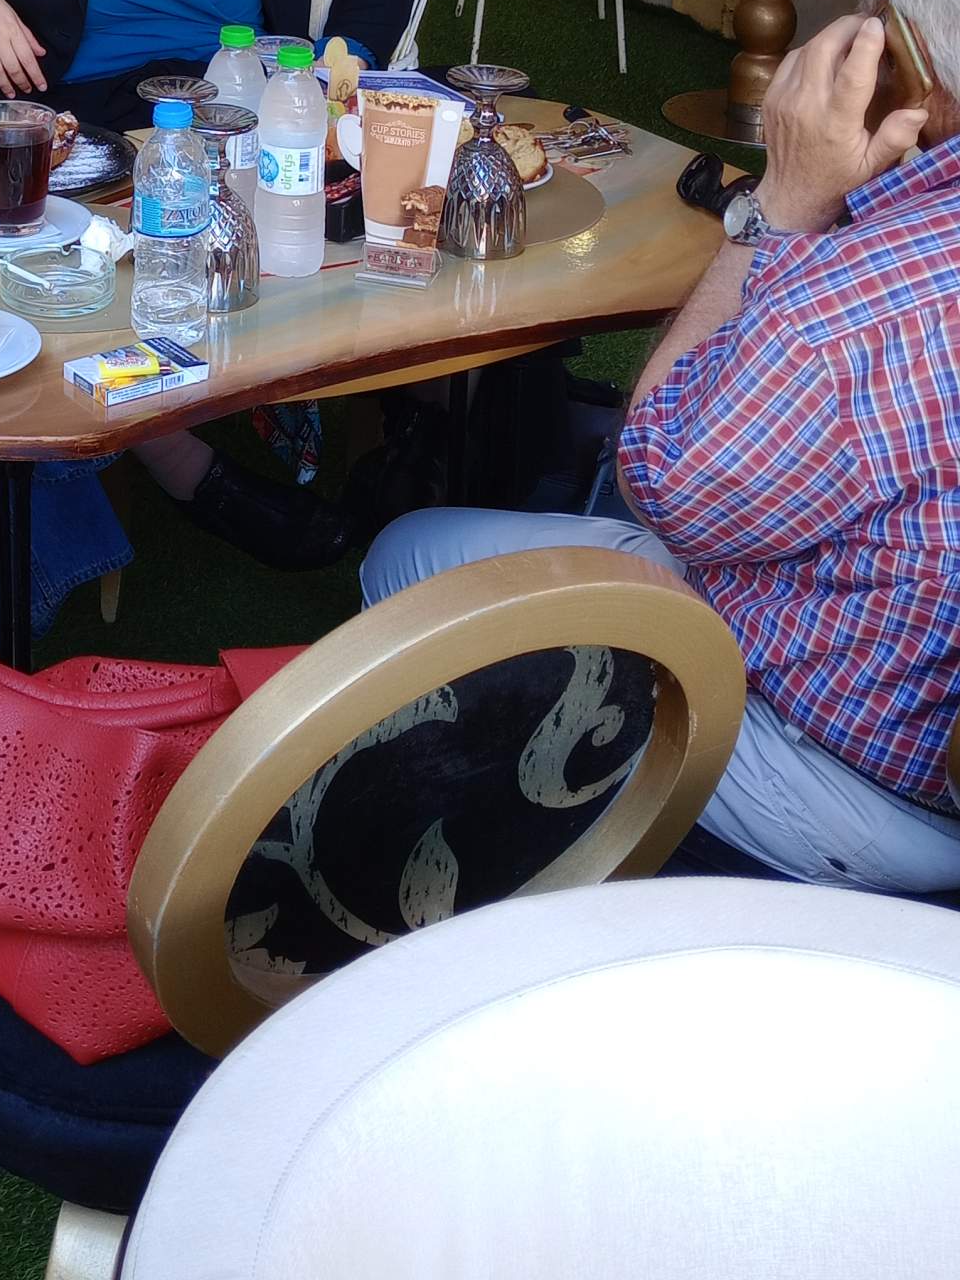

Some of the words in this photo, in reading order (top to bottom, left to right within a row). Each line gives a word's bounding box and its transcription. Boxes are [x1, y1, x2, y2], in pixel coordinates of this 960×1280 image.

[371, 125, 389, 134] CUP
[390, 127, 426, 139] STORIES
[281, 154, 296, 190] dirfys
